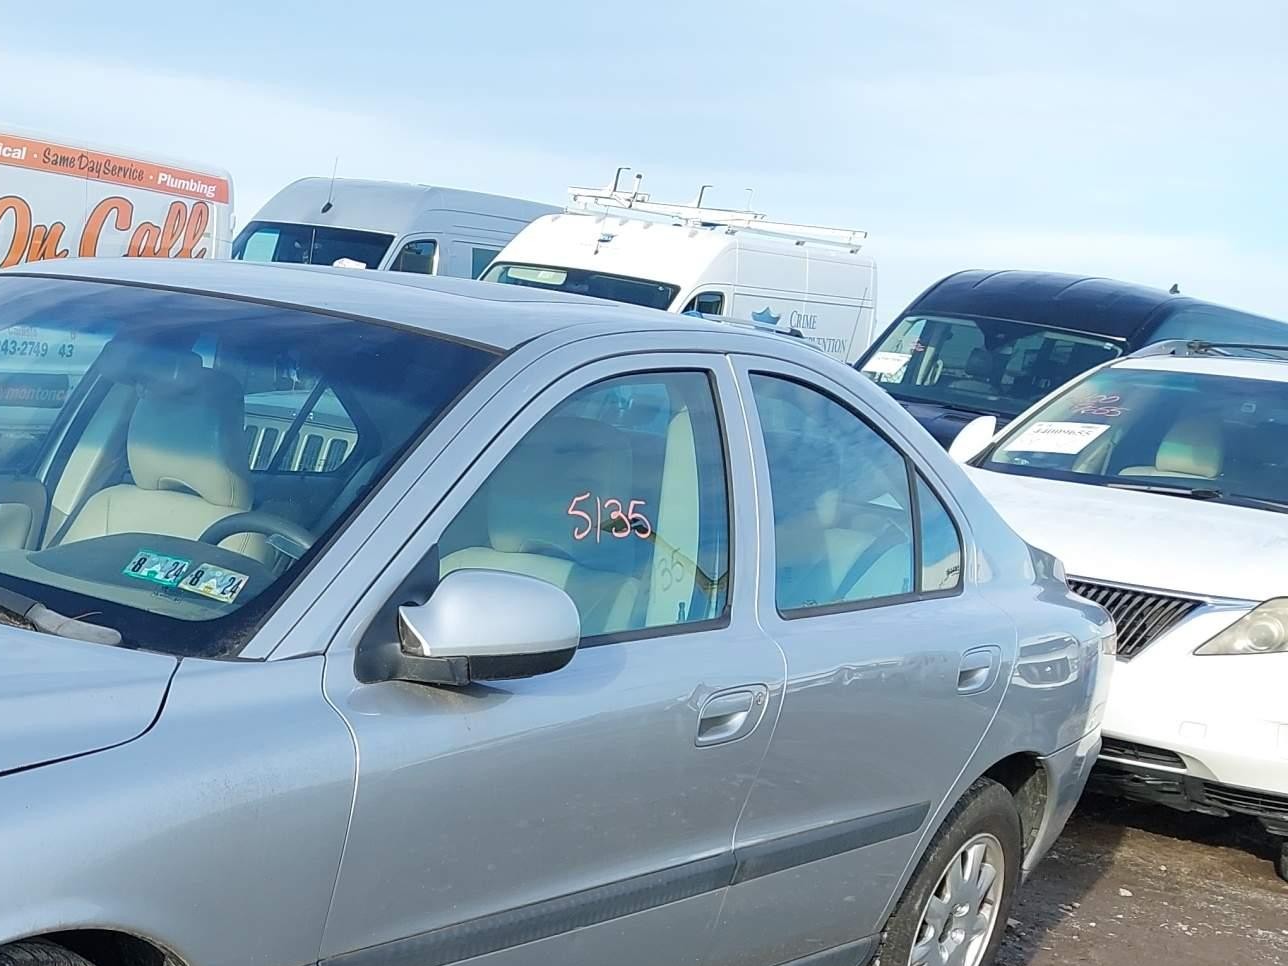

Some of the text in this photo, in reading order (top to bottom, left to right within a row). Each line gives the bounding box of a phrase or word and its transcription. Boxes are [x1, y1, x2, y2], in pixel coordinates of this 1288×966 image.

[42, 147, 76, 169] Same
[77, 155, 101, 178] Day
[102, 162, 144, 182] Service
[157, 172, 217, 197] Plumbing
[79, 196, 210, 258] Call
[567, 491, 652, 544] 5135
